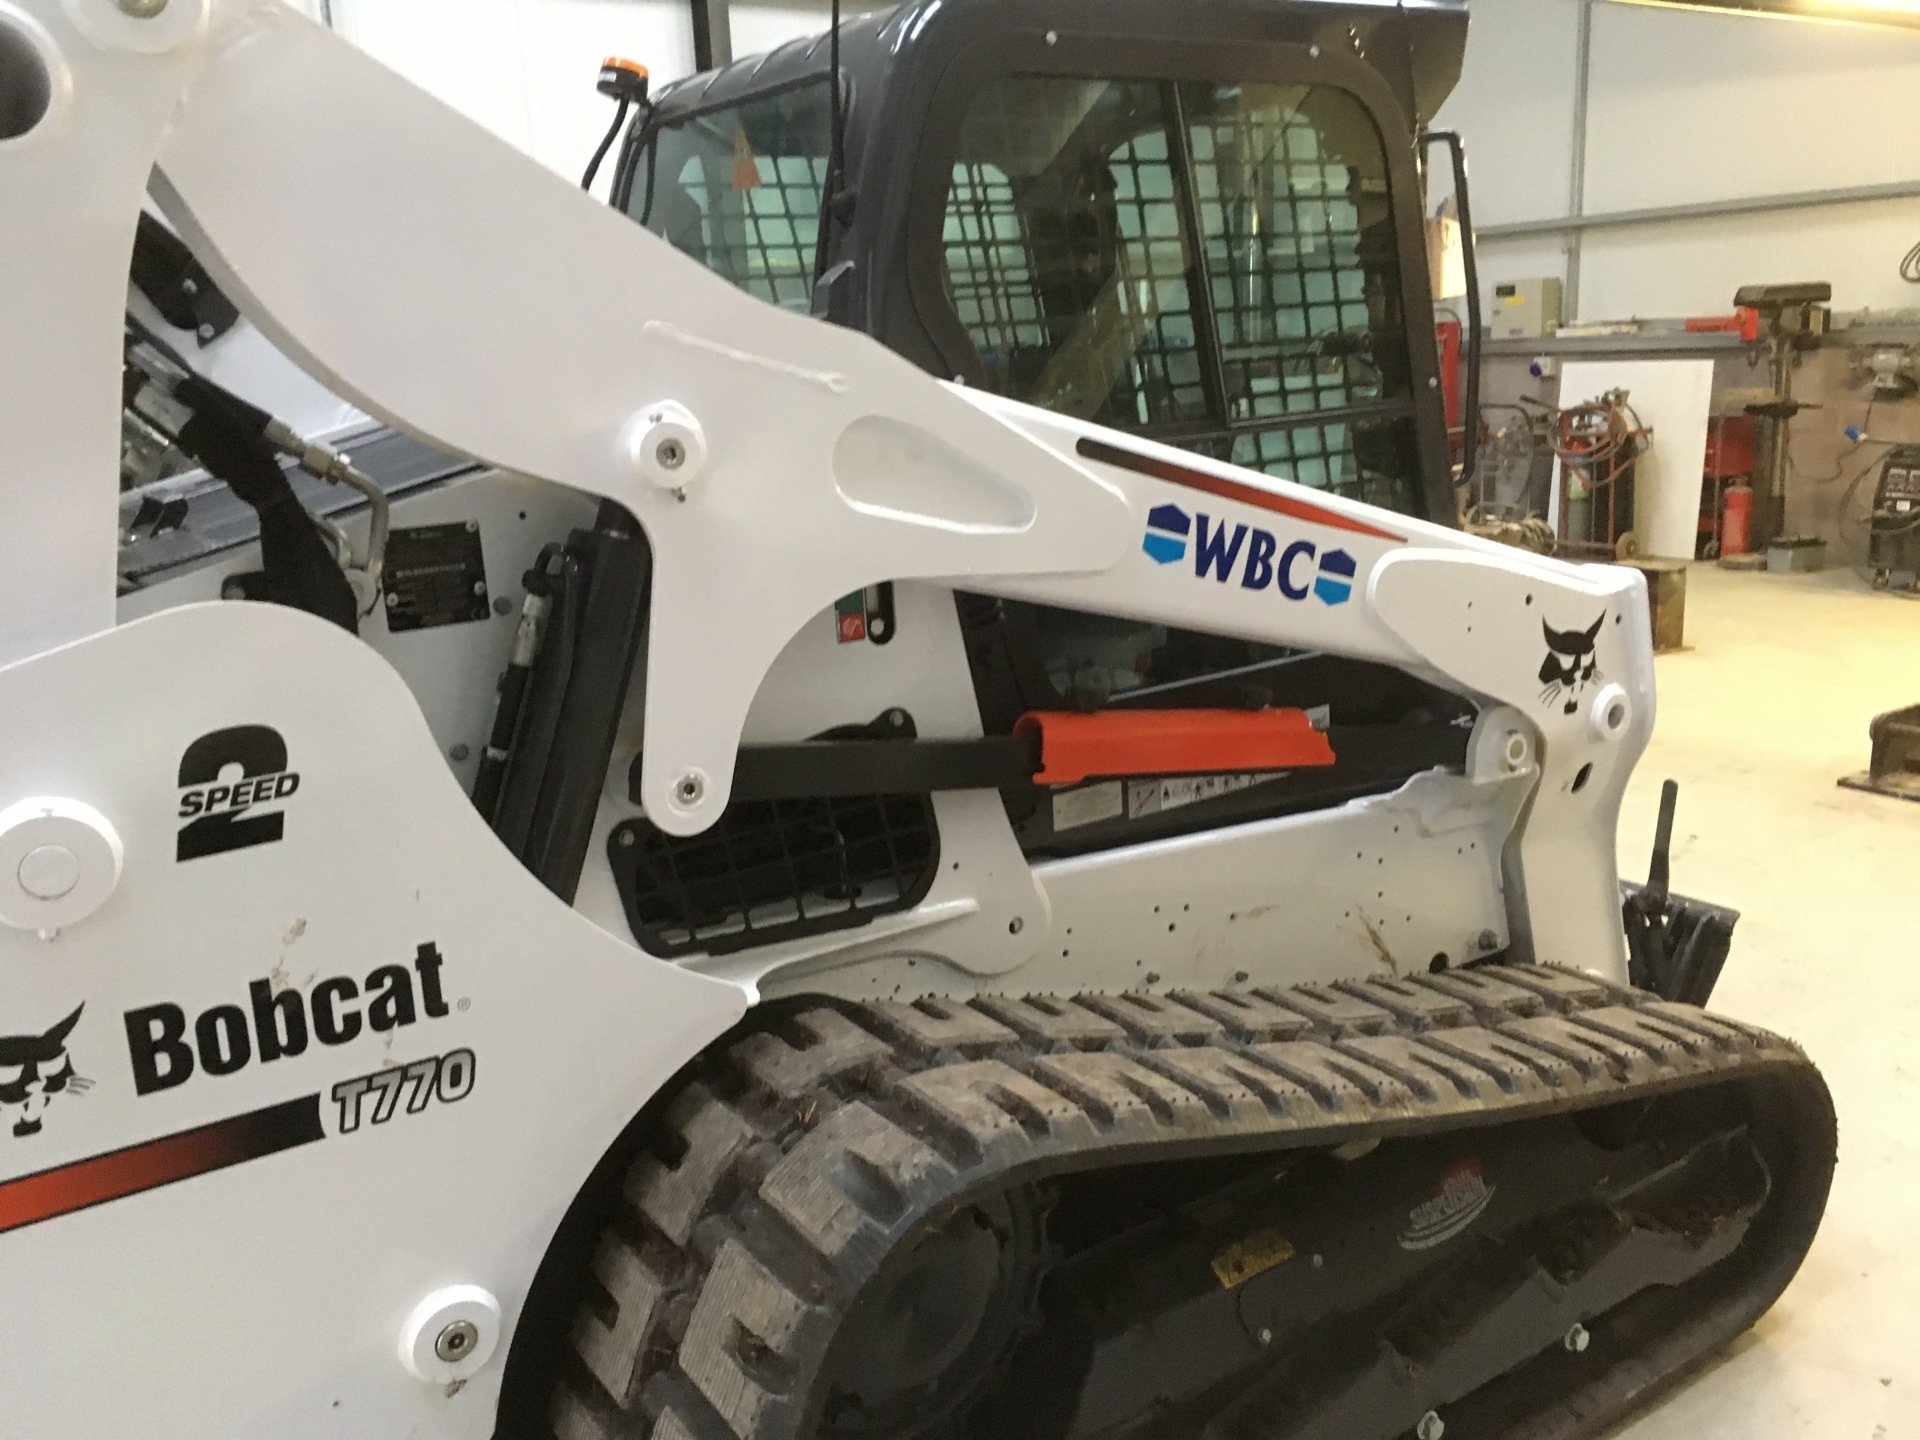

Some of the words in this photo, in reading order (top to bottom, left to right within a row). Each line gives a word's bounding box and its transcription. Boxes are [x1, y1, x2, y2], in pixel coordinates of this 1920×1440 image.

[1195, 513, 1316, 601] WBC
[177, 724, 288, 862] 2
[179, 772, 300, 818] SPEED
[124, 941, 449, 1096] Bobcat
[332, 1048, 476, 1134] T770
